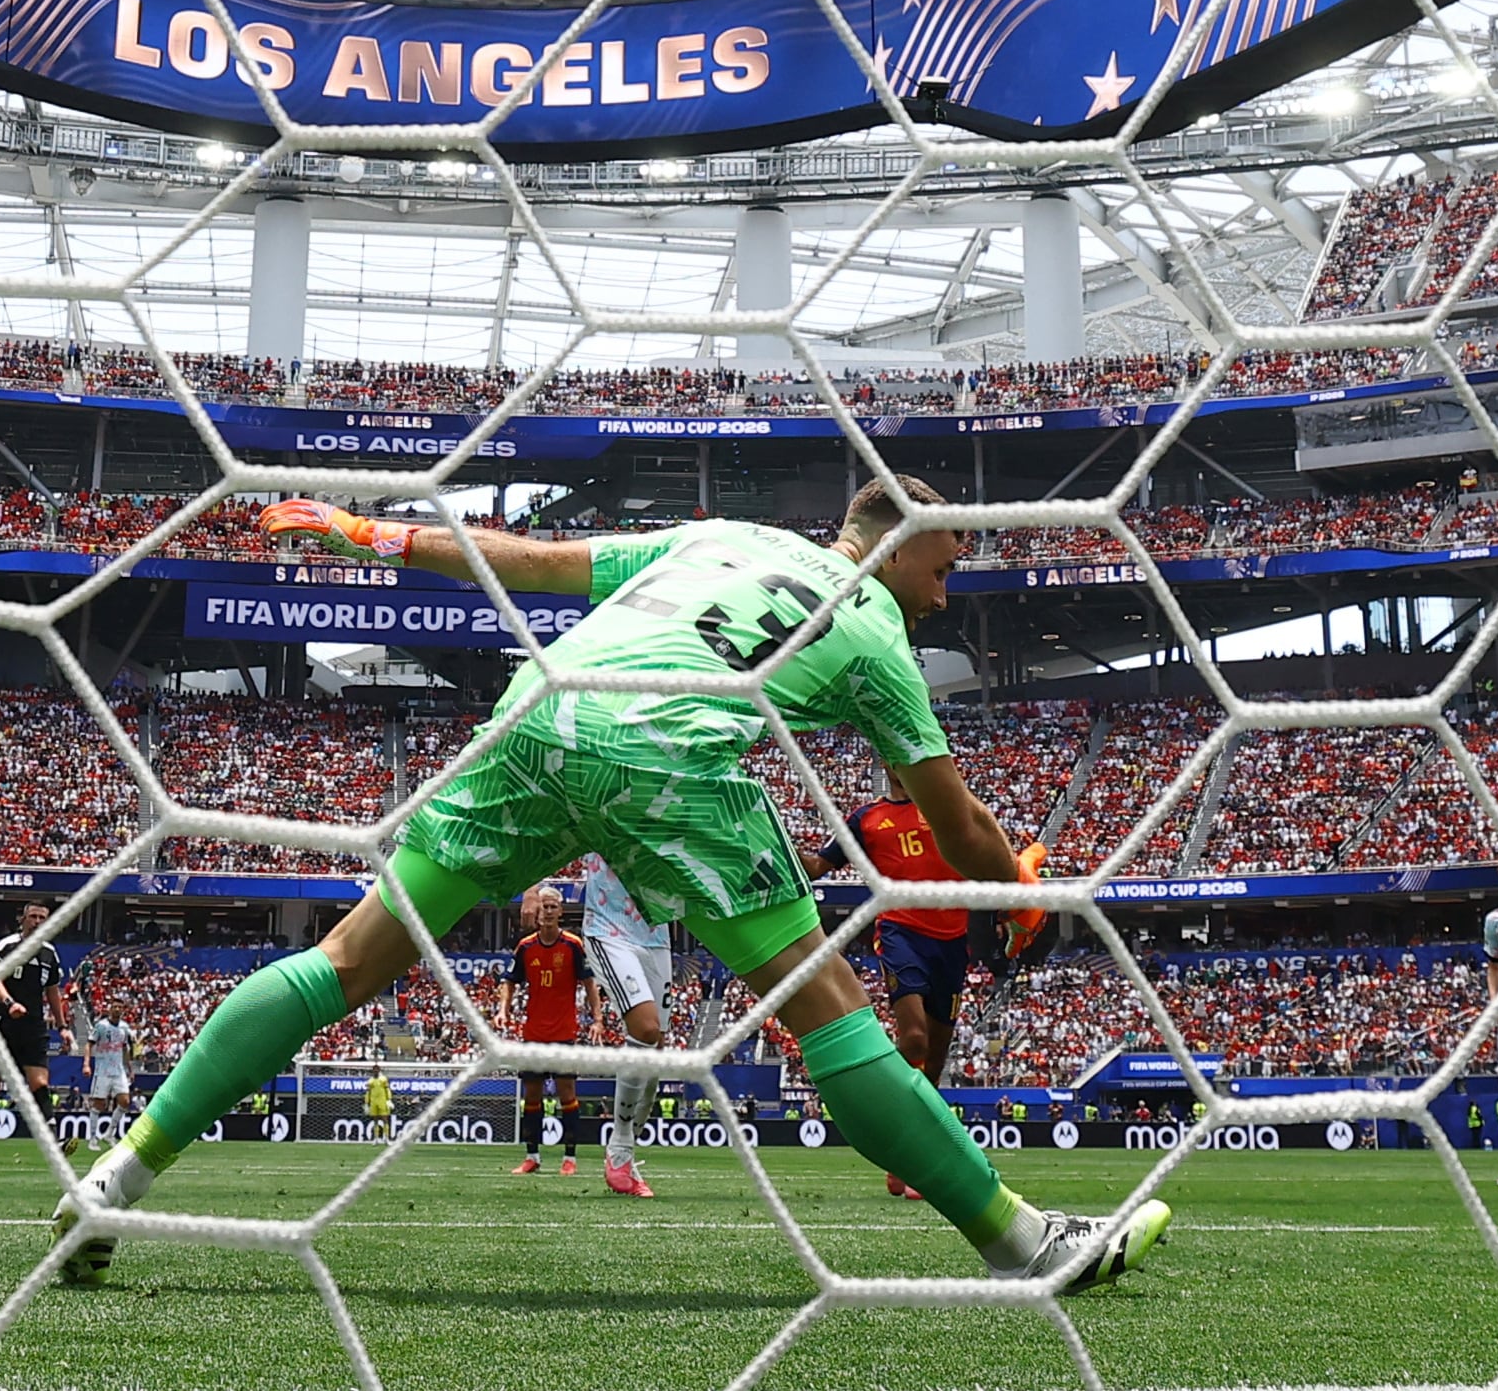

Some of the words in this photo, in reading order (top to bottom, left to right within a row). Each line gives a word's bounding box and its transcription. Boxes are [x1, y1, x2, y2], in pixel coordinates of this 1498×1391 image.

[321, 25, 771, 109] ANGELES
[346, 414, 354, 426] S
[359, 415, 432, 429] ANGELES
[598, 420, 631, 435] FIFA
[632, 420, 685, 435] WORLD
[686, 421, 717, 435] CUP
[718, 421, 772, 435] 2026
[958, 420, 966, 432] S
[971, 416, 1043, 432] ANGELES
[296, 433, 360, 452] LOS
[367, 436, 517, 457] ANGEES
[275, 565, 287, 582] S
[294, 566, 399, 586] ANGELES
[1026, 569, 1039, 587] S
[1046, 564, 1148, 586] ANGELES
[206, 598, 274, 625] FIFA
[279, 602, 397, 631] WORLD
[402, 606, 466, 632] CUP
[897, 829, 925, 858] 16
[1115, 883, 1168, 898] WORLD
[1169, 883, 1198, 897] CUP
[1200, 881, 1248, 896] 2026
[540, 969, 553, 988] 10
[1129, 1061, 1148, 1071] FIFA
[1148, 1061, 1178, 1071] WORLD
